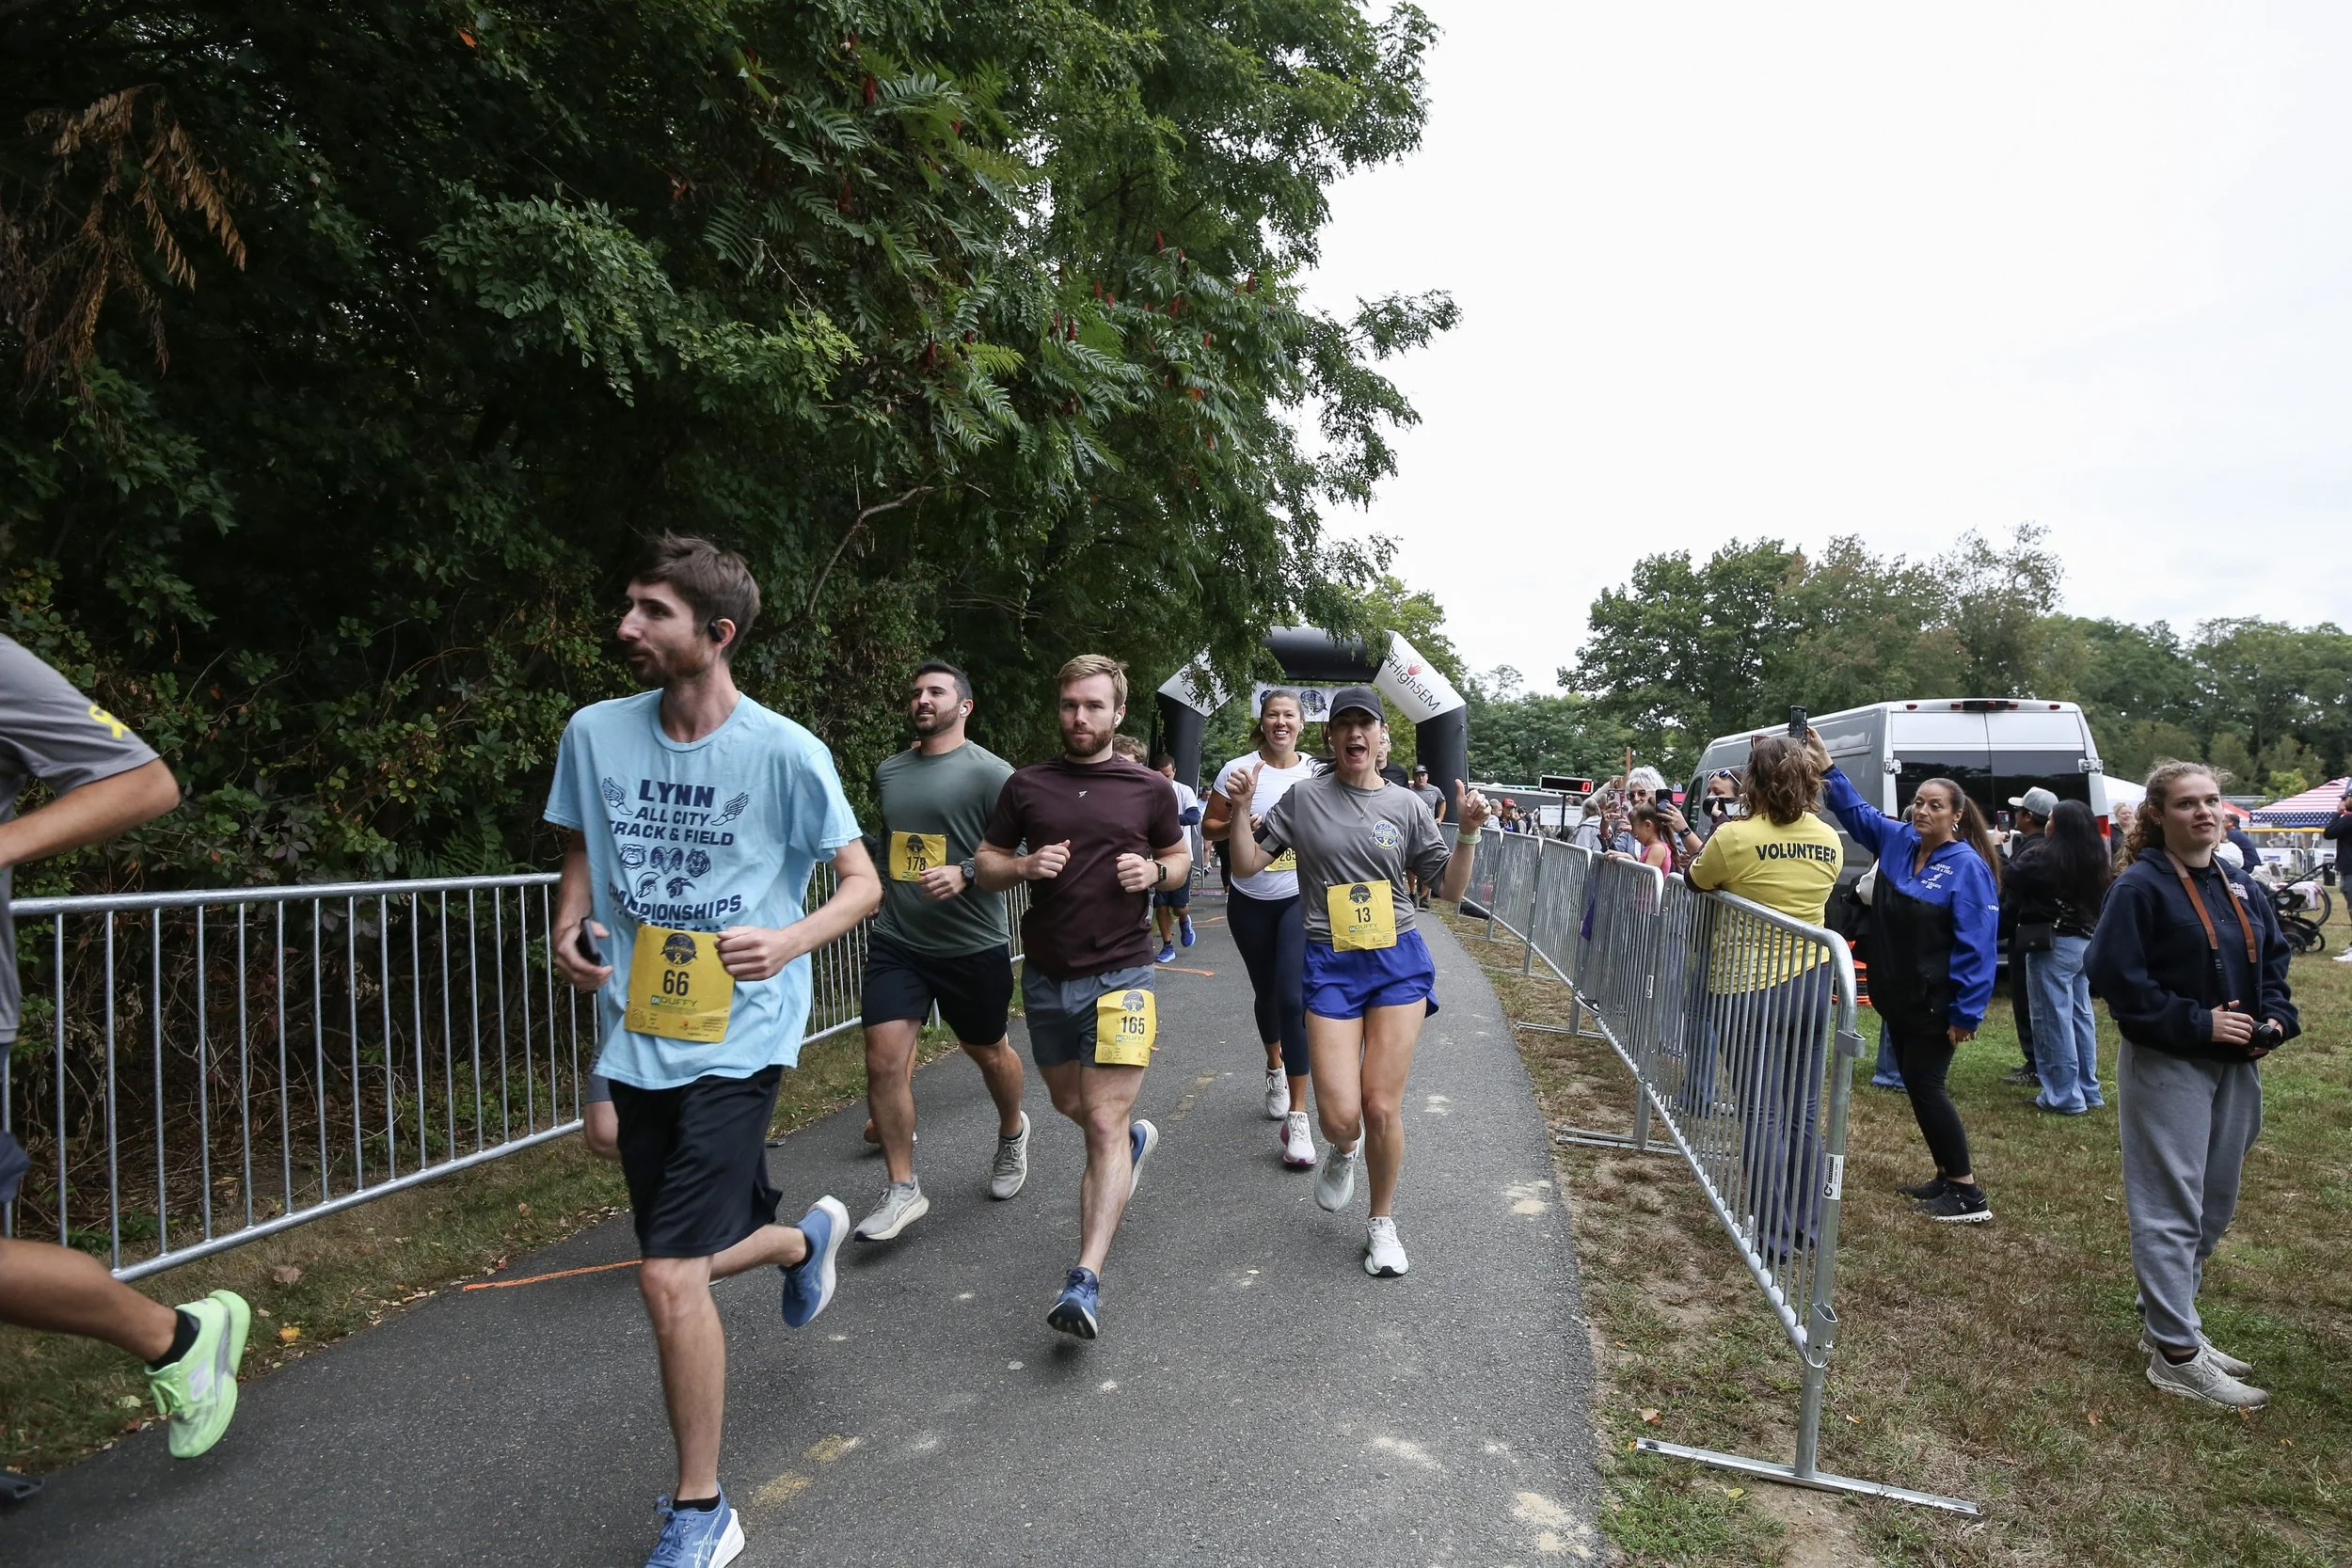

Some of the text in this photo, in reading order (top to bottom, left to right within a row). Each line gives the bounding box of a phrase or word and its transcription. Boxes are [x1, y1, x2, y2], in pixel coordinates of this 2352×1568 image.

[1388, 658, 1441, 711] High5EM
[639, 779, 715, 808] LYNN
[634, 807, 710, 827] ALL CITY
[669, 828, 679, 841] &
[684, 830, 734, 846] FIELD
[907, 856, 926, 871] 178
[1755, 843, 1836, 864] VOLUNTEER
[609, 881, 741, 921] AMPIONSHIPS
[1355, 907, 1371, 923] 13
[662, 969, 690, 996] 66
[1121, 1016, 1145, 1035] 165
